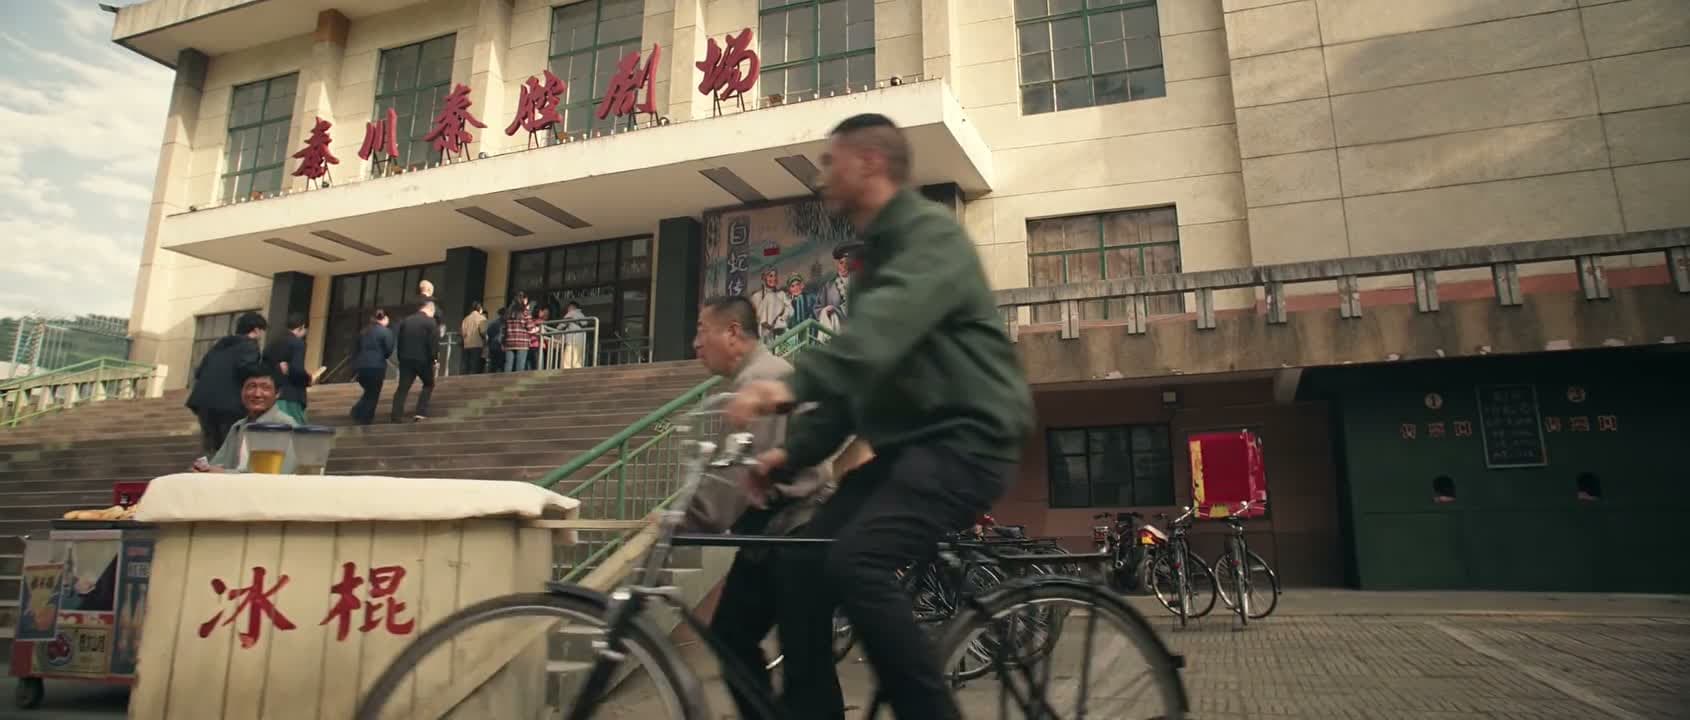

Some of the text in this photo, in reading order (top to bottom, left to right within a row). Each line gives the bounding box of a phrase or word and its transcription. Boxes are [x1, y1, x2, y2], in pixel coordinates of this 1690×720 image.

[291, 27, 761, 180] 秦川秦腔剧场
[198, 561, 415, 649] 冰棍
